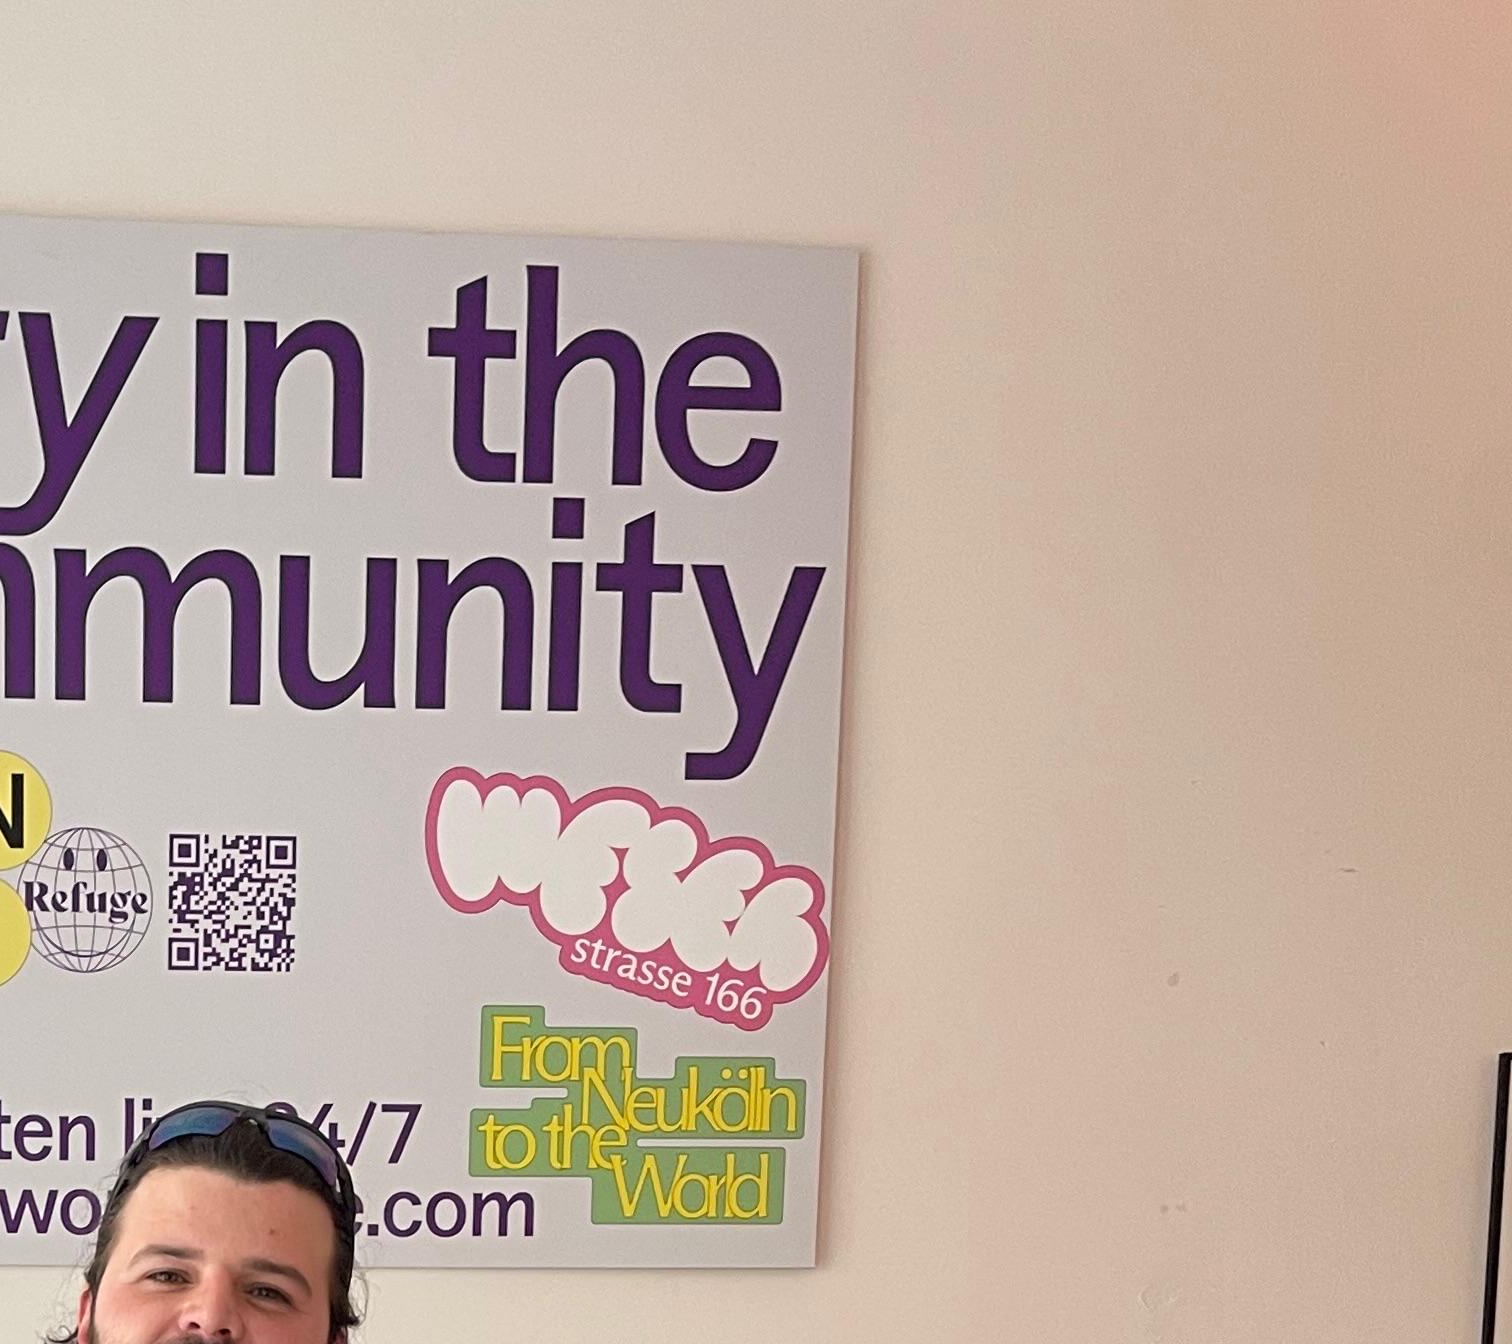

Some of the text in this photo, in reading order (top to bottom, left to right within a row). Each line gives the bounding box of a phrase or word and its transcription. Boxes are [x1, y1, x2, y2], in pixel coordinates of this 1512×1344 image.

[194, 252, 364, 478] in
[428, 264, 782, 492] the
[23, 880, 148, 924] Refuge
[571, 937, 767, 1020] strasse 166
[491, 1015, 632, 1081] From
[582, 1066, 796, 1132] Neukölln
[478, 1104, 627, 1169] to the
[610, 1154, 769, 1218] World
